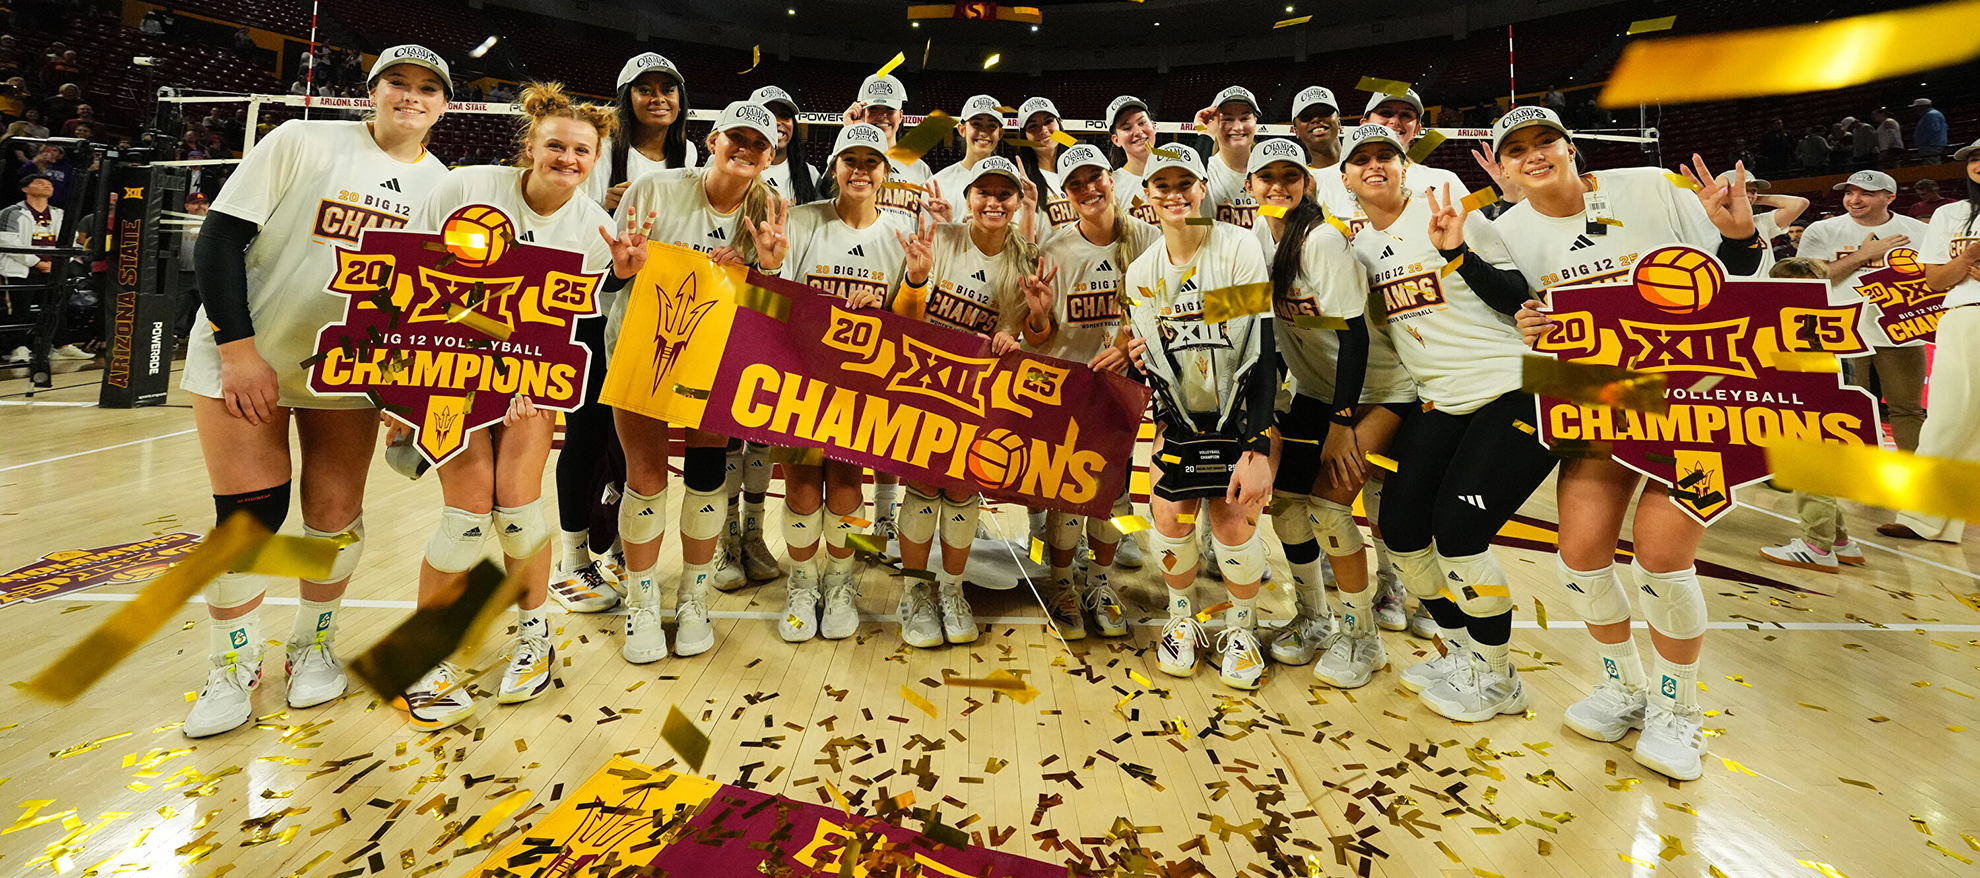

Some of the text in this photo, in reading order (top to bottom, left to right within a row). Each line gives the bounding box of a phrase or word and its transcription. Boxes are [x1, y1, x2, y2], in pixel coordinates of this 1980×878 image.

[320, 97, 351, 106] ARIZONA
[465, 103, 488, 111] STATE
[799, 113, 844, 122] POWER
[1457, 129, 1488, 137] ARIZONA
[338, 190, 411, 217] 20 BIG 12
[1235, 198, 1252, 206] BIG
[346, 260, 387, 285] 20
[816, 265, 885, 280] 20 BIG 12 25
[1375, 270, 1391, 283] BIG
[1393, 266, 1404, 277] 12
[1407, 262, 1423, 273] 25
[1540, 273, 1559, 286] 20
[1561, 264, 1590, 279] BIG
[1594, 258, 1614, 272] 12
[554, 279, 587, 305] 25
[941, 280, 954, 290] 20
[956, 285, 975, 299] BIG
[977, 293, 990, 304] 12
[1074, 283, 1087, 291] 20
[1090, 280, 1110, 290] BIG
[1382, 277, 1438, 312] AMPS
[1864, 285, 1884, 298] 20
[108, 219, 141, 388] ARIZONA STATE
[929, 293, 998, 332] CHAMPS
[1070, 294, 1121, 319] CHAM
[1175, 301, 1194, 313] BIG
[1898, 311, 1915, 320] BIG
[1916, 307, 1926, 315] 12
[833, 317, 872, 347] 20
[1547, 317, 1585, 344] 20
[149, 321, 163, 376] POWERADE
[409, 334, 426, 345] 12
[434, 336, 543, 357] VOLYBALL
[321, 346, 577, 400] CHAMPIONS
[886, 333, 1000, 418] XII
[1022, 363, 1058, 396] 25
[1550, 404, 1866, 447] CHAMPIONS
[1185, 465, 1195, 473] 20
